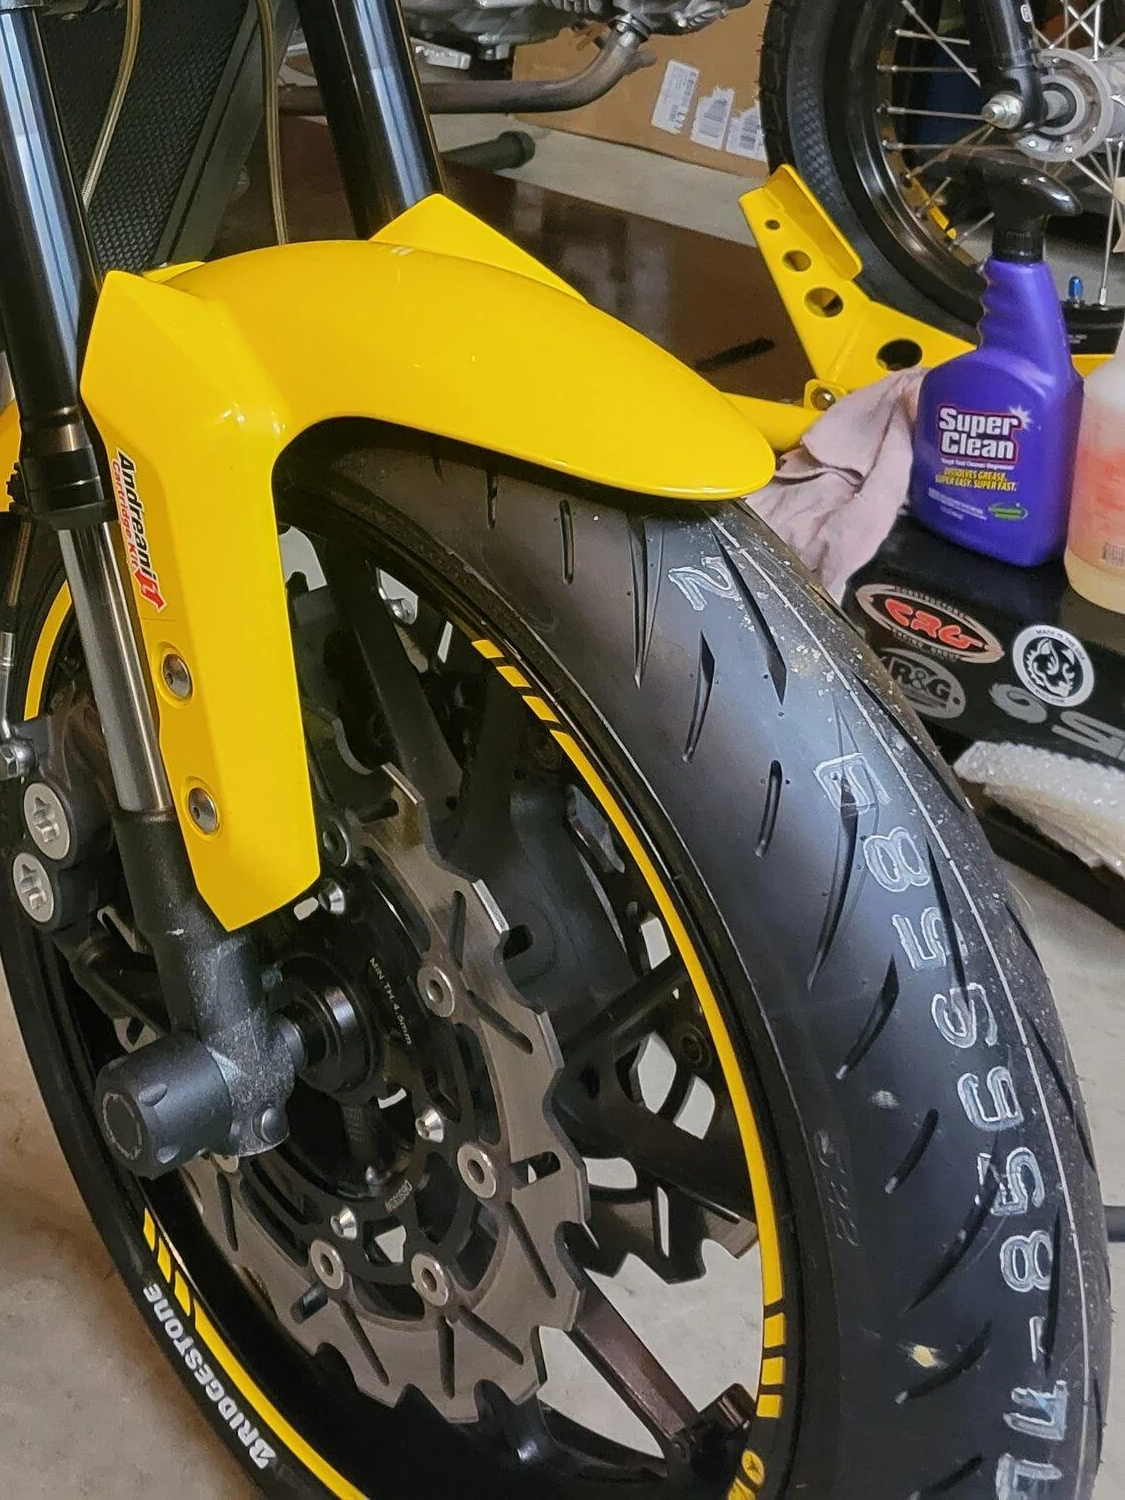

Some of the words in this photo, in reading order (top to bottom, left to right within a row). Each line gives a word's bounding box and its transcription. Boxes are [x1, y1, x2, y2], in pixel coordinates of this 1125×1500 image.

[938, 407, 1020, 437] Super
[941, 431, 1015, 460] Clean
[112, 460, 132, 540] Cartridge
[118, 450, 157, 579] Andreani
[142, 1282, 278, 1471] BRIDGESTONE
